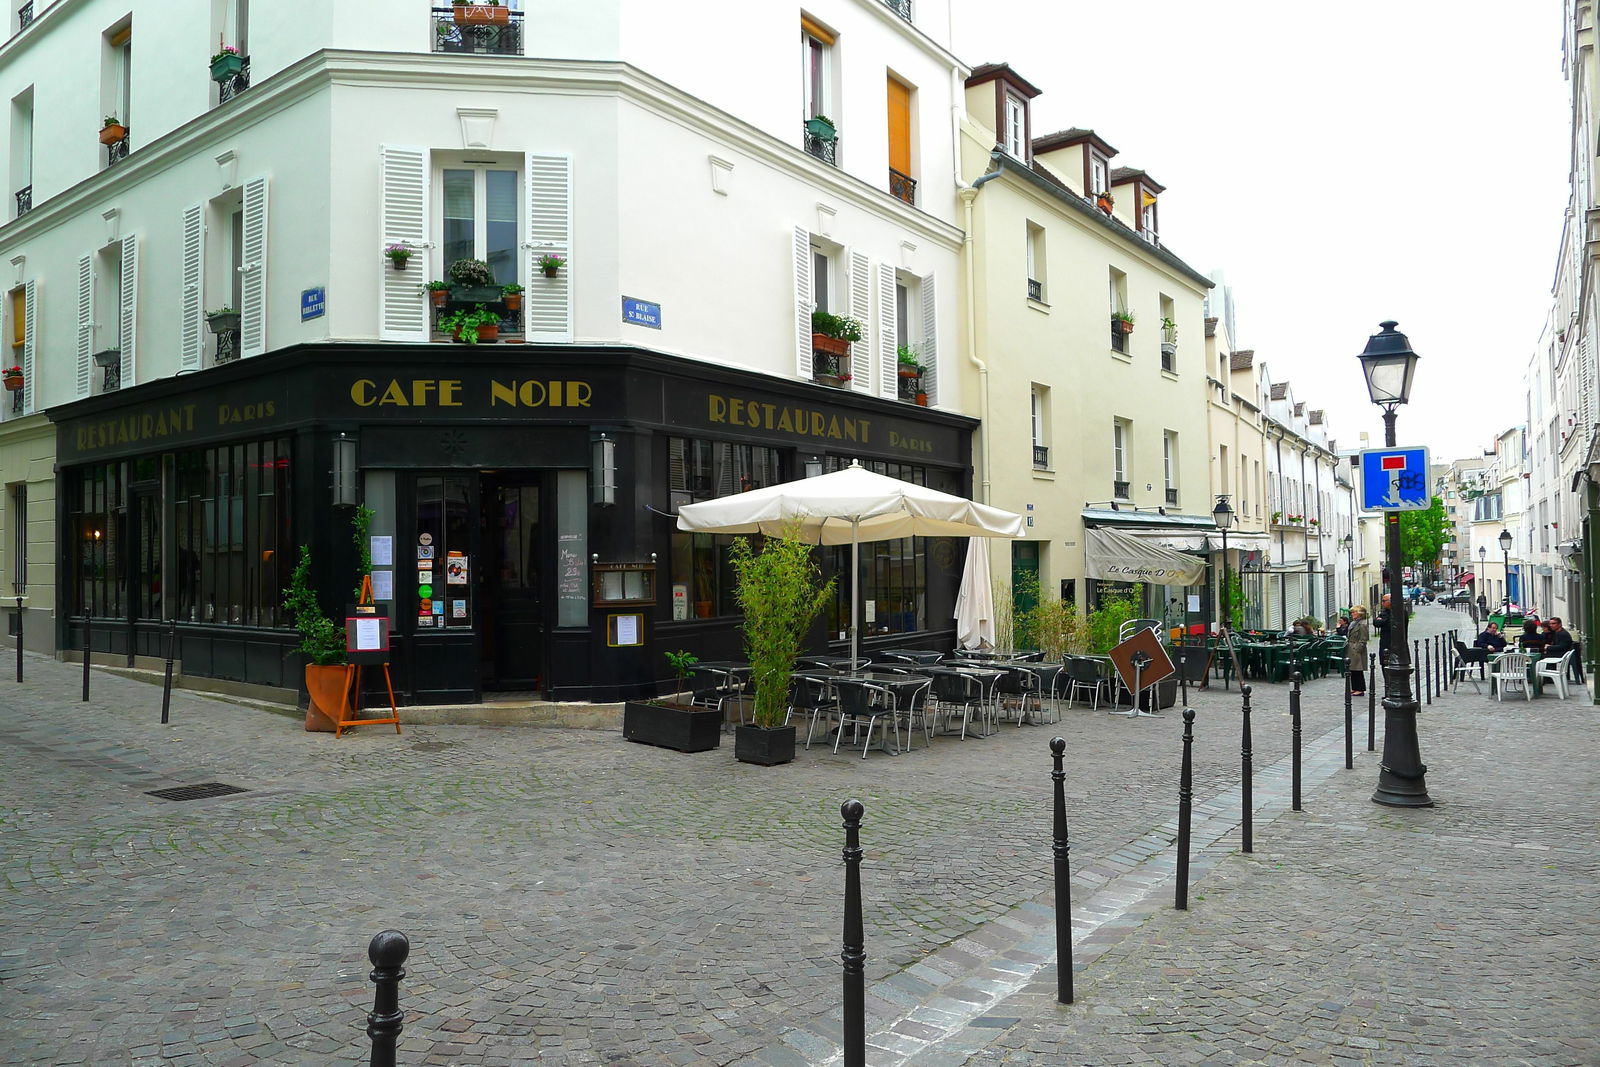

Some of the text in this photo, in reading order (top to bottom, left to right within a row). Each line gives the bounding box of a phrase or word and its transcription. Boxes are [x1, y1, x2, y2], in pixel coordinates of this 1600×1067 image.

[635, 303, 649, 313] RUE
[635, 312, 656, 324] BLAISE
[350, 378, 592, 407] CAFE NOIR
[76, 404, 196, 451] RESTAURANT
[708, 394, 871, 443] RESTAURANT
[1107, 565, 1119, 573] Le
[1121, 566, 1153, 578] Casque
